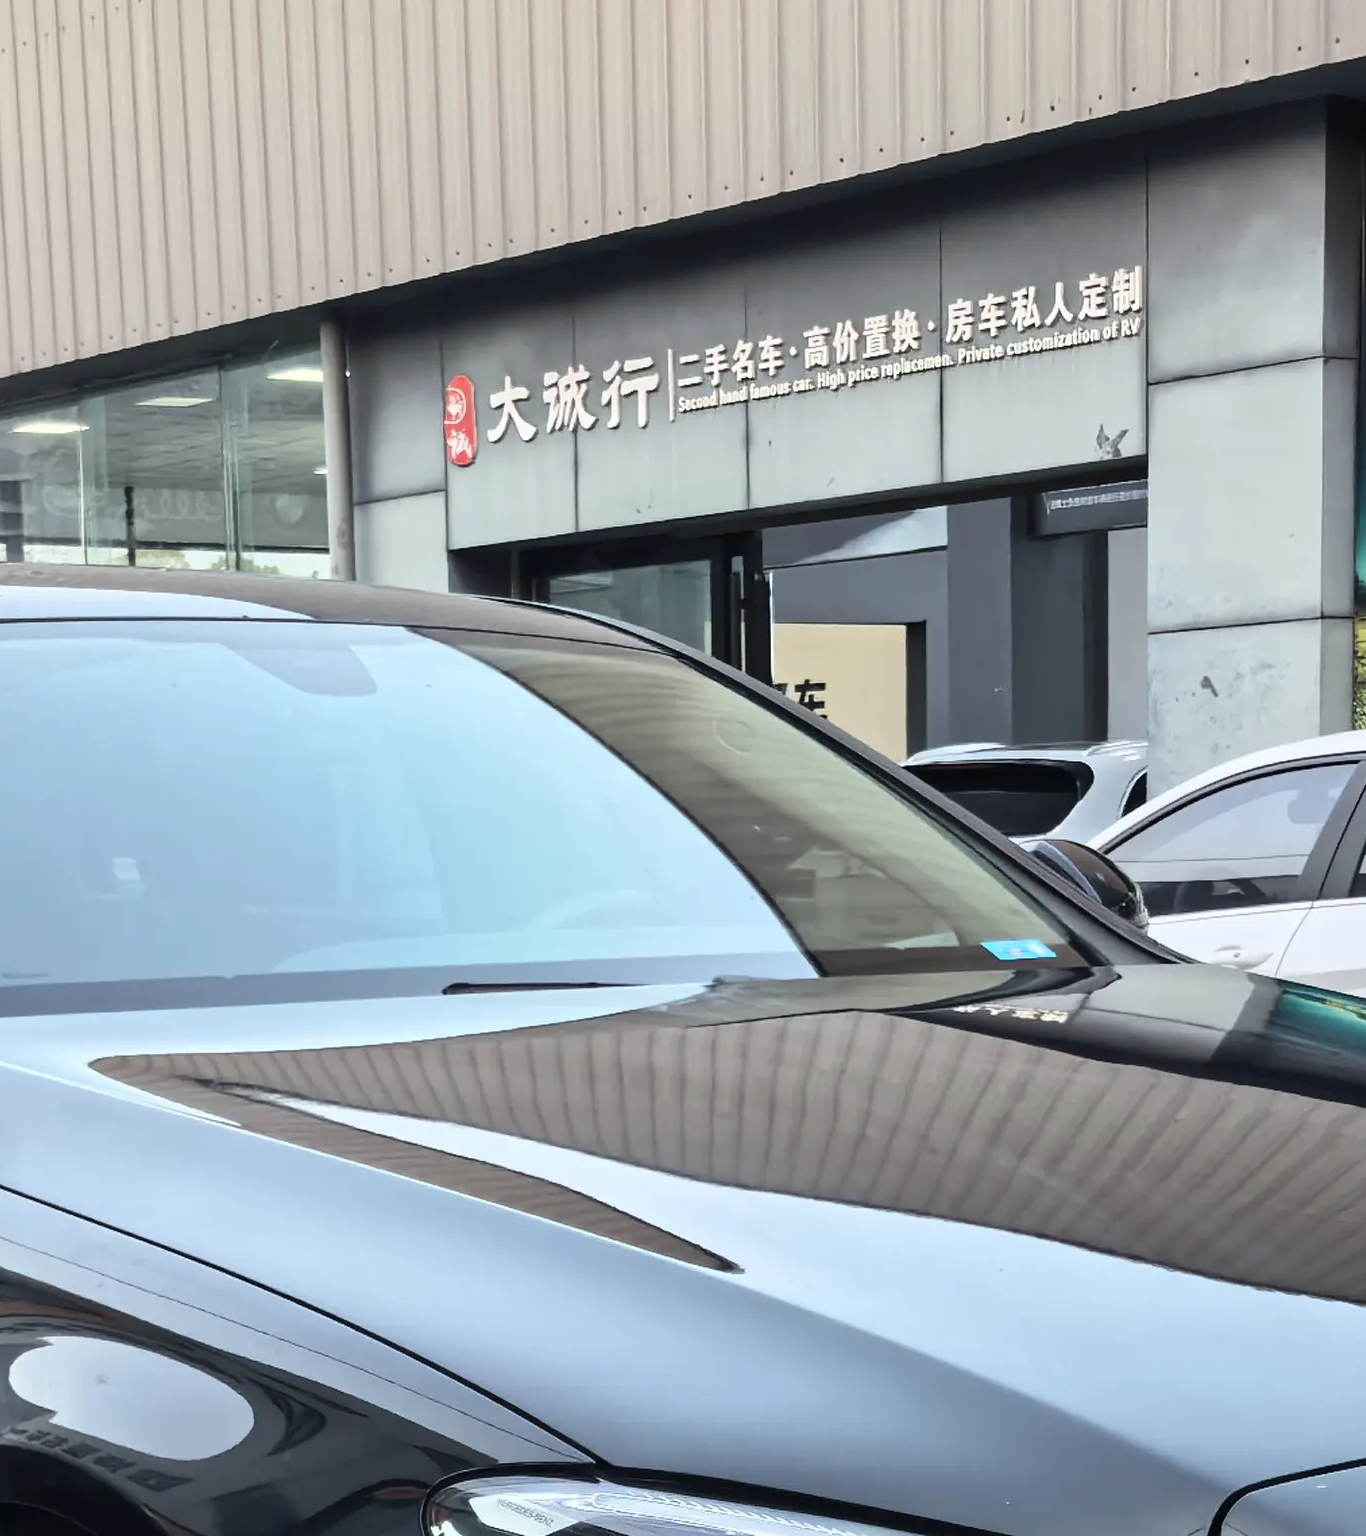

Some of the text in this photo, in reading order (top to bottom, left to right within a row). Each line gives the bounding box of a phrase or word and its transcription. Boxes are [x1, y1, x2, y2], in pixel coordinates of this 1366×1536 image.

[487, 356, 660, 443] 大诚行
[678, 393, 718, 412] Second
[720, 386, 748, 406] hand
[750, 381, 792, 401] famous
[817, 371, 847, 391] High
[849, 365, 879, 388] price
[958, 343, 1005, 365] Private
[1007, 327, 1100, 356] customization
[1103, 319, 1120, 340] of
[1121, 317, 1142, 337] RV
